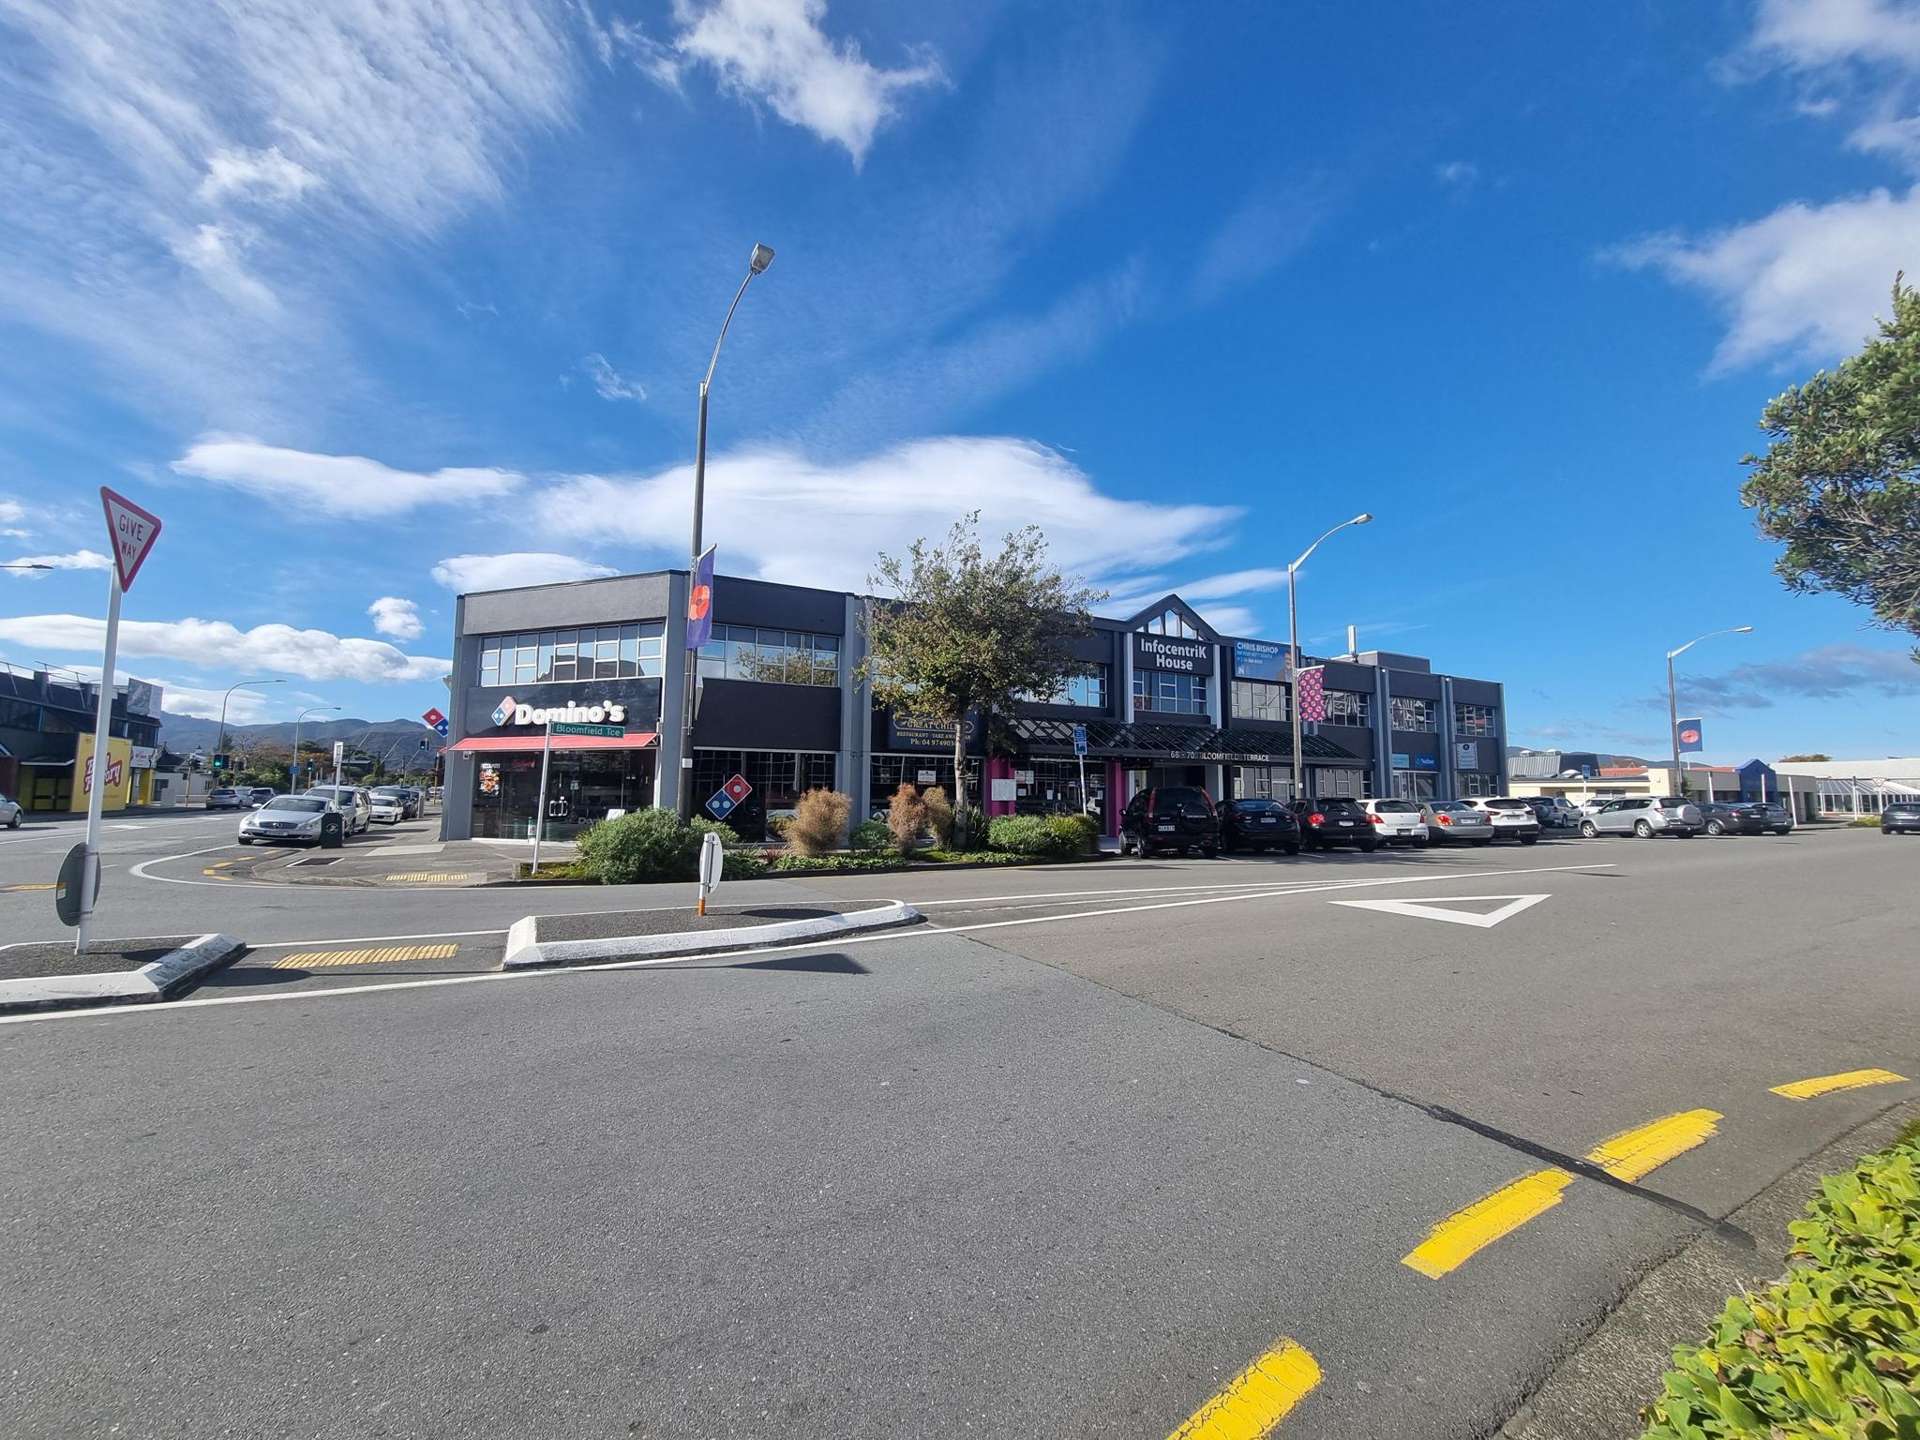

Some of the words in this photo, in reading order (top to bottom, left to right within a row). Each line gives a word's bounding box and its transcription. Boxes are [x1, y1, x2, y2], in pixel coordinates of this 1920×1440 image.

[119, 513, 144, 542] GIVE
[121, 541, 137, 560] WAY
[1140, 638, 1207, 659] InfocentriK
[1256, 644, 1279, 654] BISHOP
[1156, 654, 1193, 671] House
[514, 700, 625, 725] Domino's
[556, 724, 603, 736] Bloomfield
[606, 727, 620, 737] Tce
